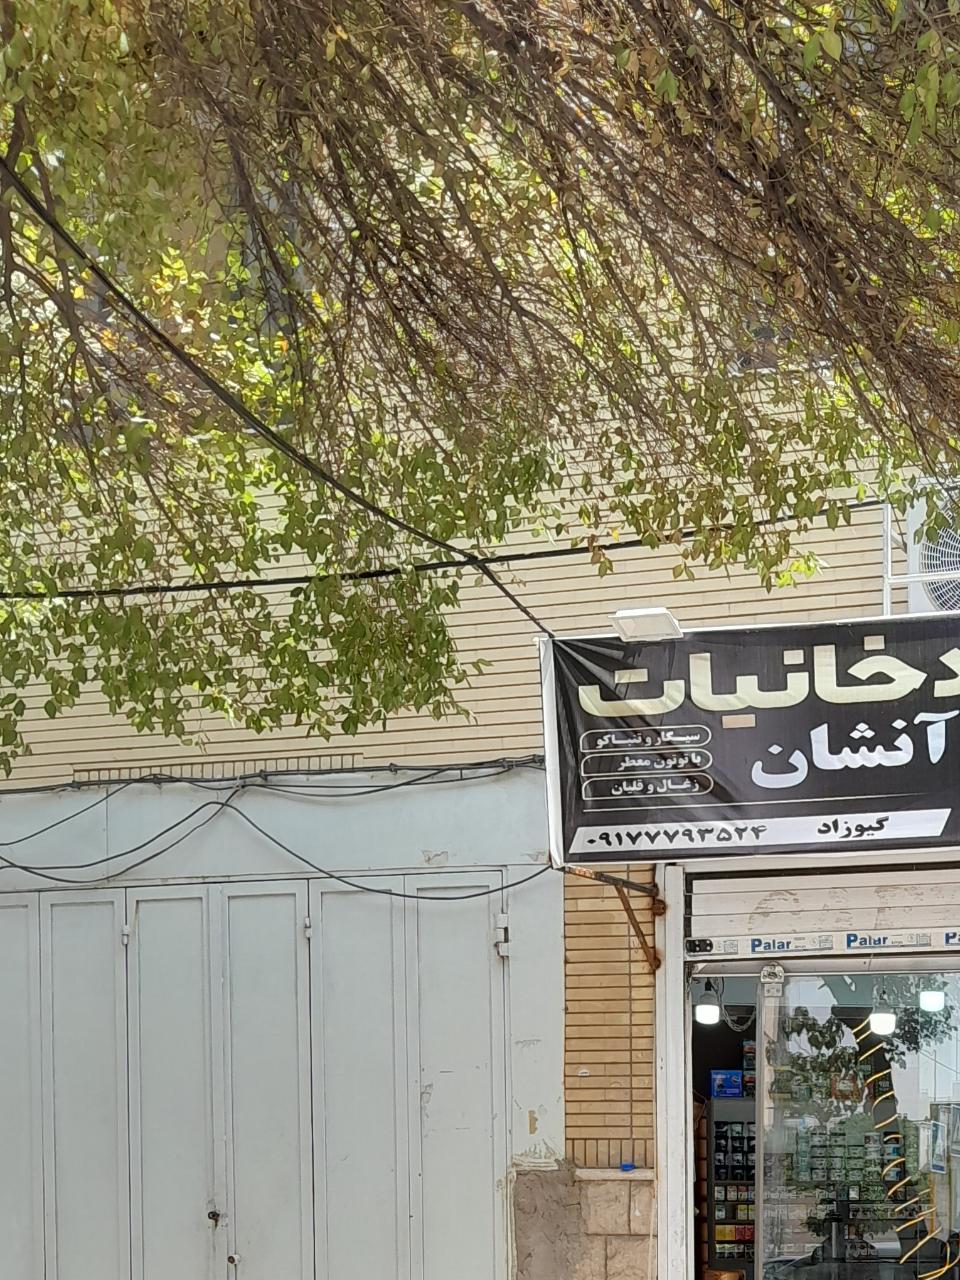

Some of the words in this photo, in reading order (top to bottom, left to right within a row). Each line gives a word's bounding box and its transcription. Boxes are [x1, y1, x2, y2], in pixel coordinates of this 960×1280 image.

[596, 733, 642, 749] تنباکو
[645, 736, 652, 746] و
[655, 731, 701, 746] سیگار
[751, 710, 960, 789] آنشان
[617, 756, 651, 771] معطر
[653, 754, 690, 769] توتون
[690, 752, 701, 766] با
[611, 780, 644, 795] قلیان
[647, 784, 654, 794] و
[656, 778, 700, 792] زغال
[817, 816, 890, 839] گیوزاد
[586, 825, 769, 847] ۰۹۱۷۷۷۹۳۵۲۴
[751, 938, 792, 952] Palar
[846, 933, 888, 949] Palar
